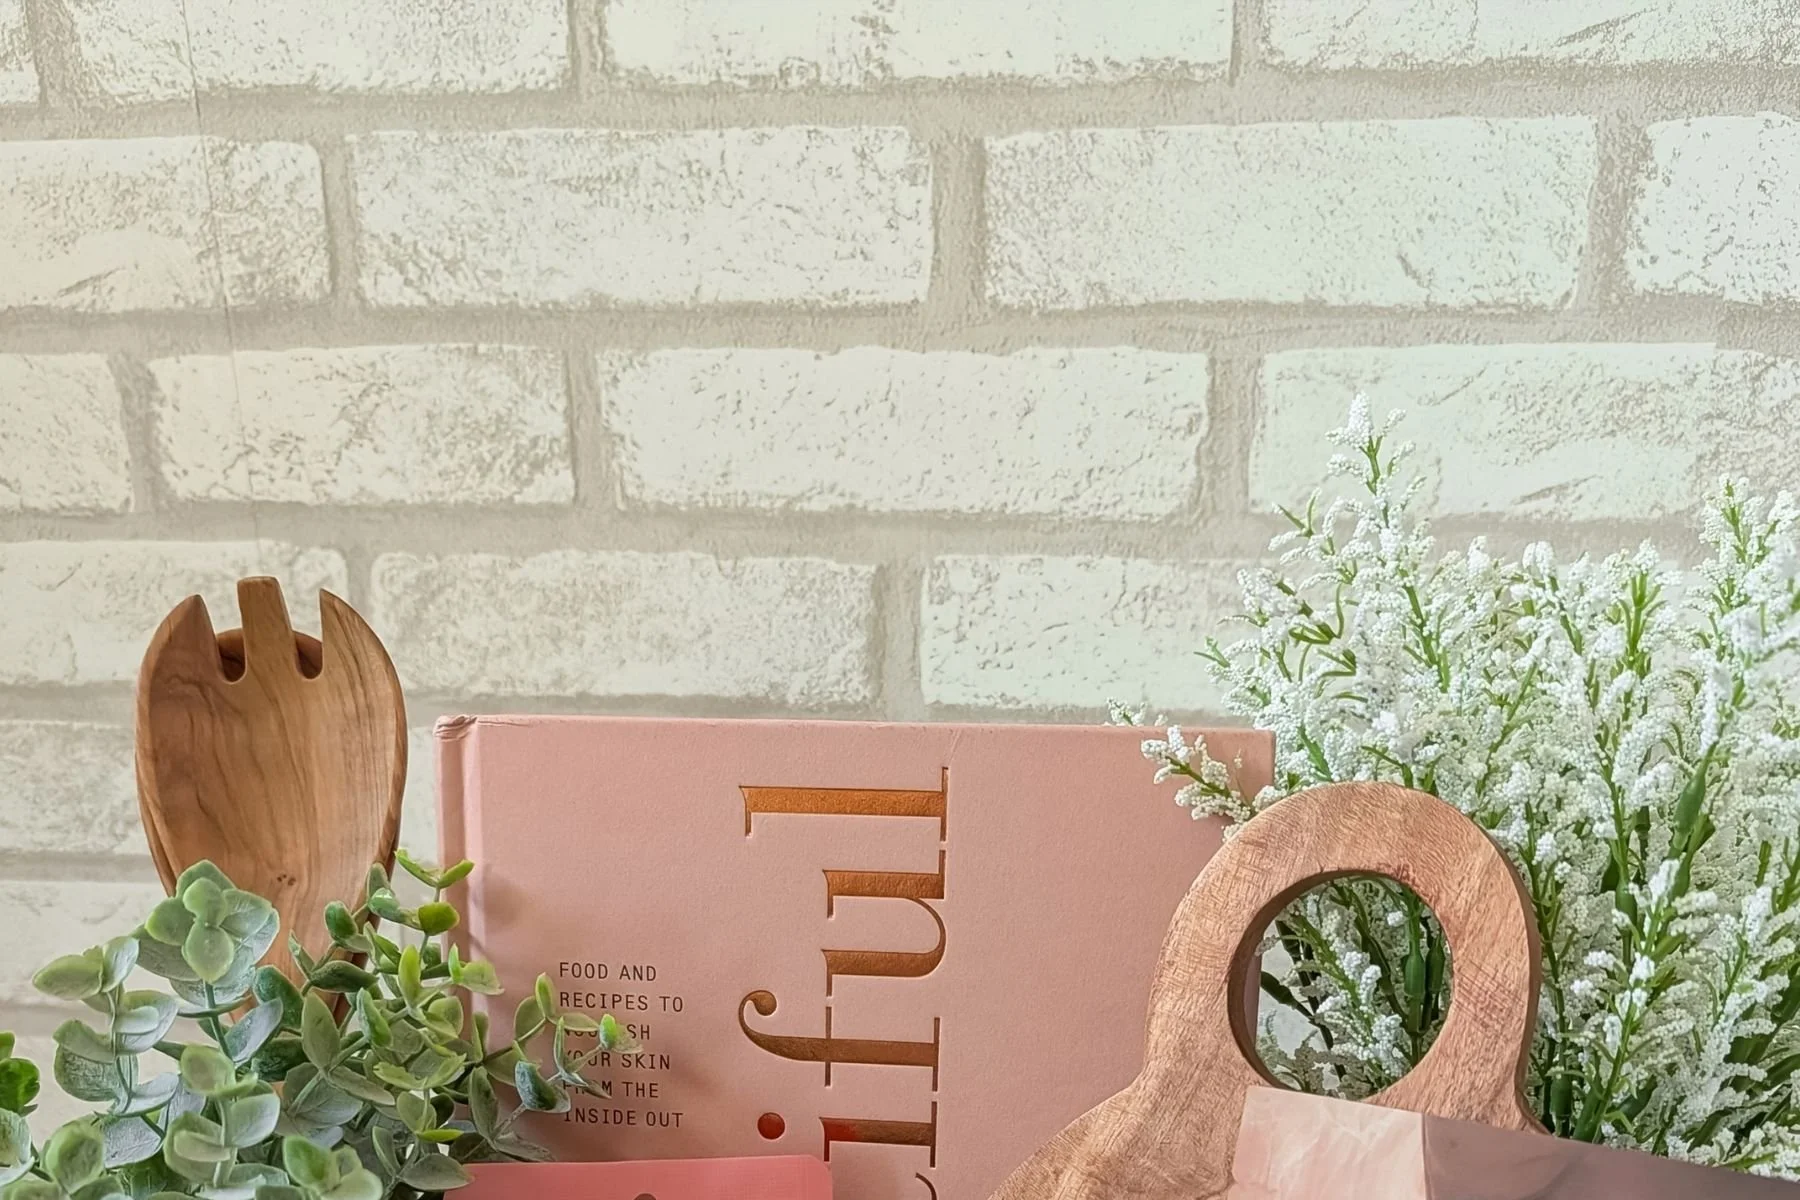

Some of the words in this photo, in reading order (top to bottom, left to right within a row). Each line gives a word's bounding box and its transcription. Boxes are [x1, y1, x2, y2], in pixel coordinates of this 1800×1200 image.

[559, 962, 608, 980] FOOD
[619, 964, 657, 982] AND
[559, 991, 649, 1011] RECIPES
[658, 996, 684, 1013] TO
[621, 1053, 671, 1070] SKIN
[621, 1081, 659, 1098] THE
[563, 1107, 637, 1126] INSIDE
[646, 1111, 684, 1128] OUT
